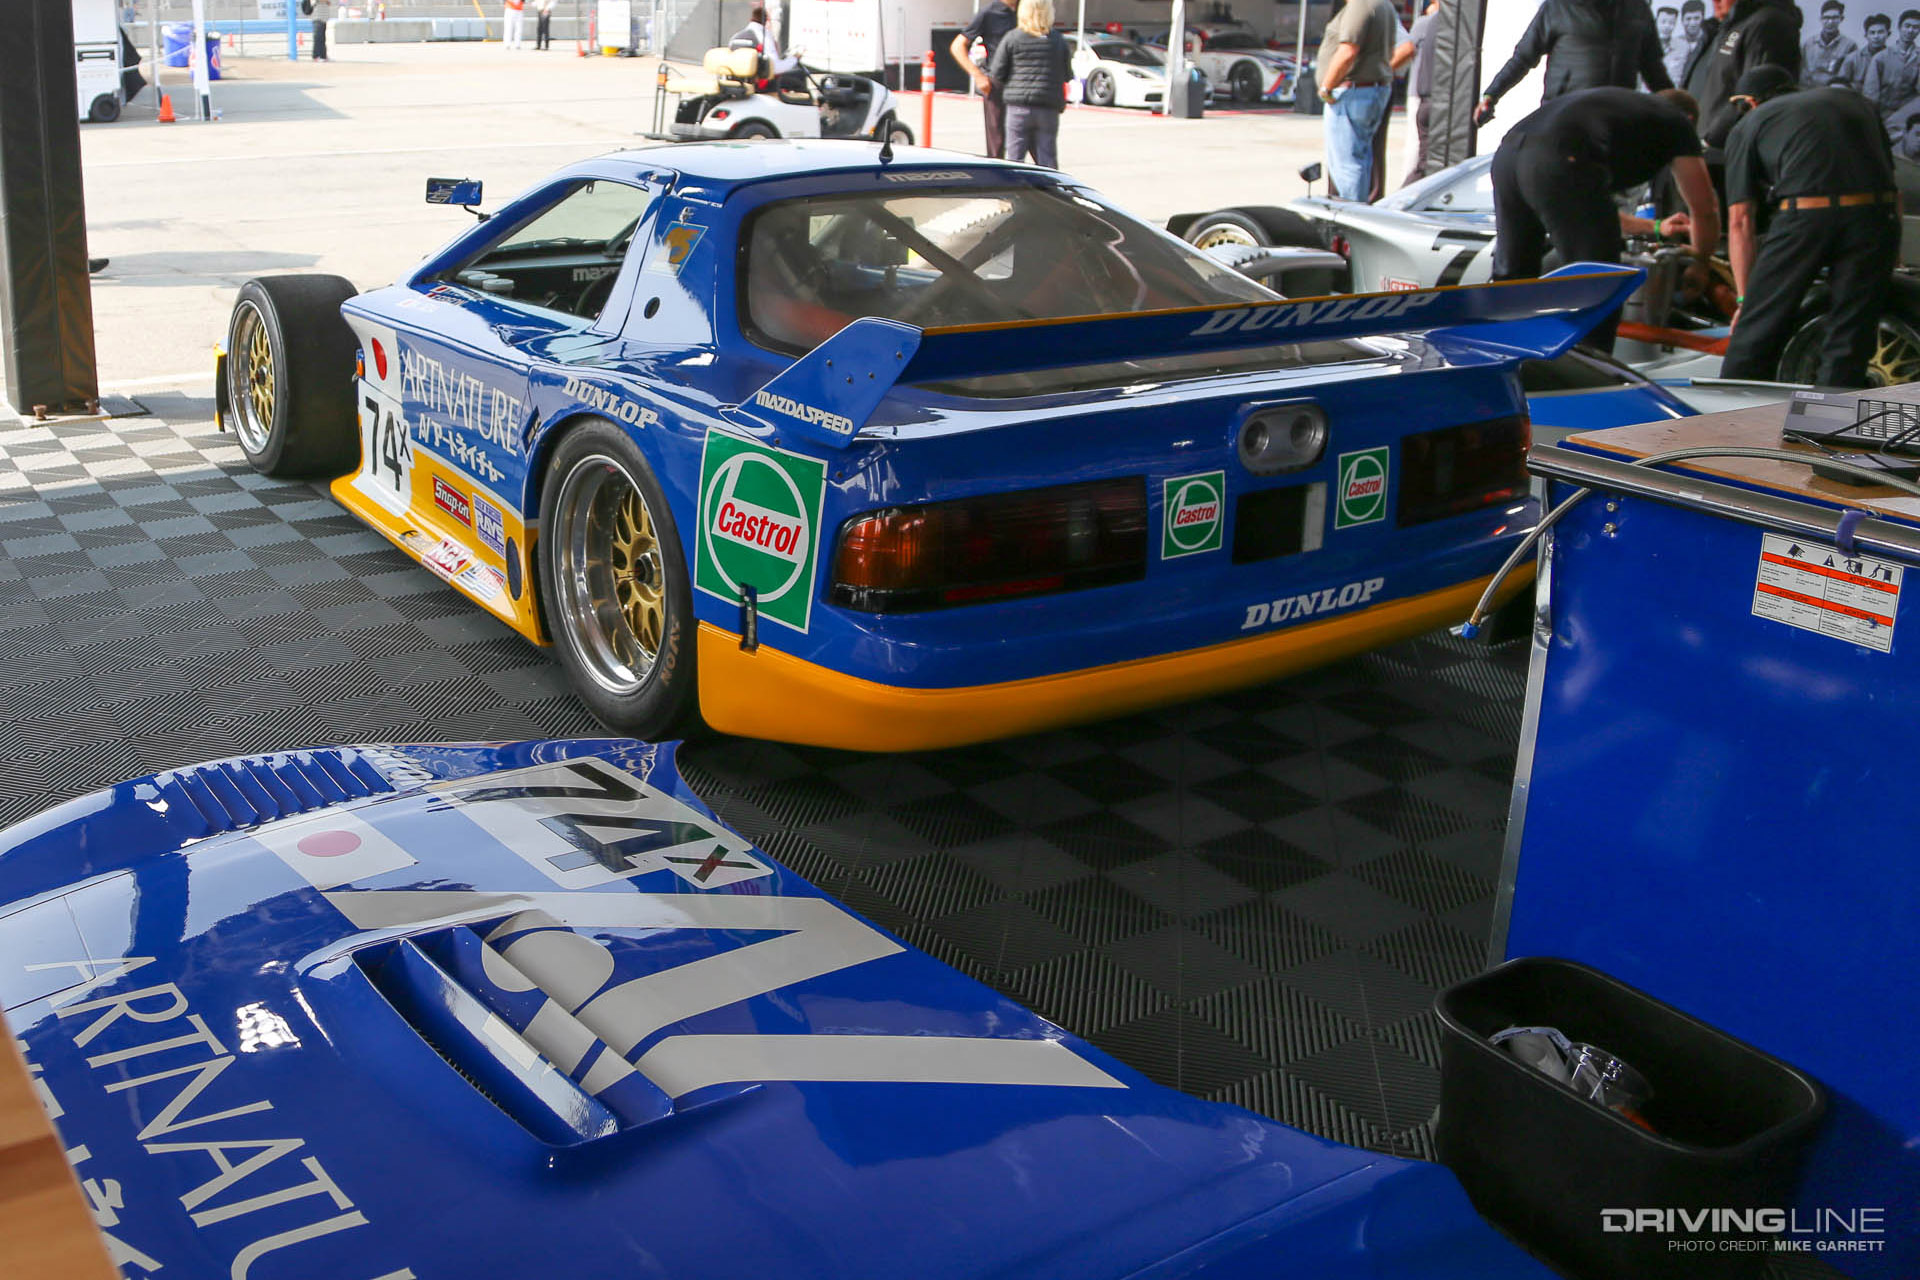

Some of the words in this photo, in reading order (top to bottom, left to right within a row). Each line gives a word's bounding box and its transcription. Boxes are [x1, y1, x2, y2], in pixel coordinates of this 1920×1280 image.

[573, 266, 620, 281] maz
[1189, 291, 1441, 337] DUNLOP
[401, 348, 521, 457] ARTNATURE
[562, 375, 659, 429] DUNLOP
[755, 390, 854, 436] MAZDASPEED
[434, 480, 471, 520] Snap-on
[1348, 477, 1382, 498] Castrol
[718, 501, 802, 556] Castrol
[1176, 503, 1217, 526] Castrol
[429, 538, 472, 572] NGK
[1241, 577, 1385, 630] DUNLOP
[24, 956, 416, 1280] ARTNATU
